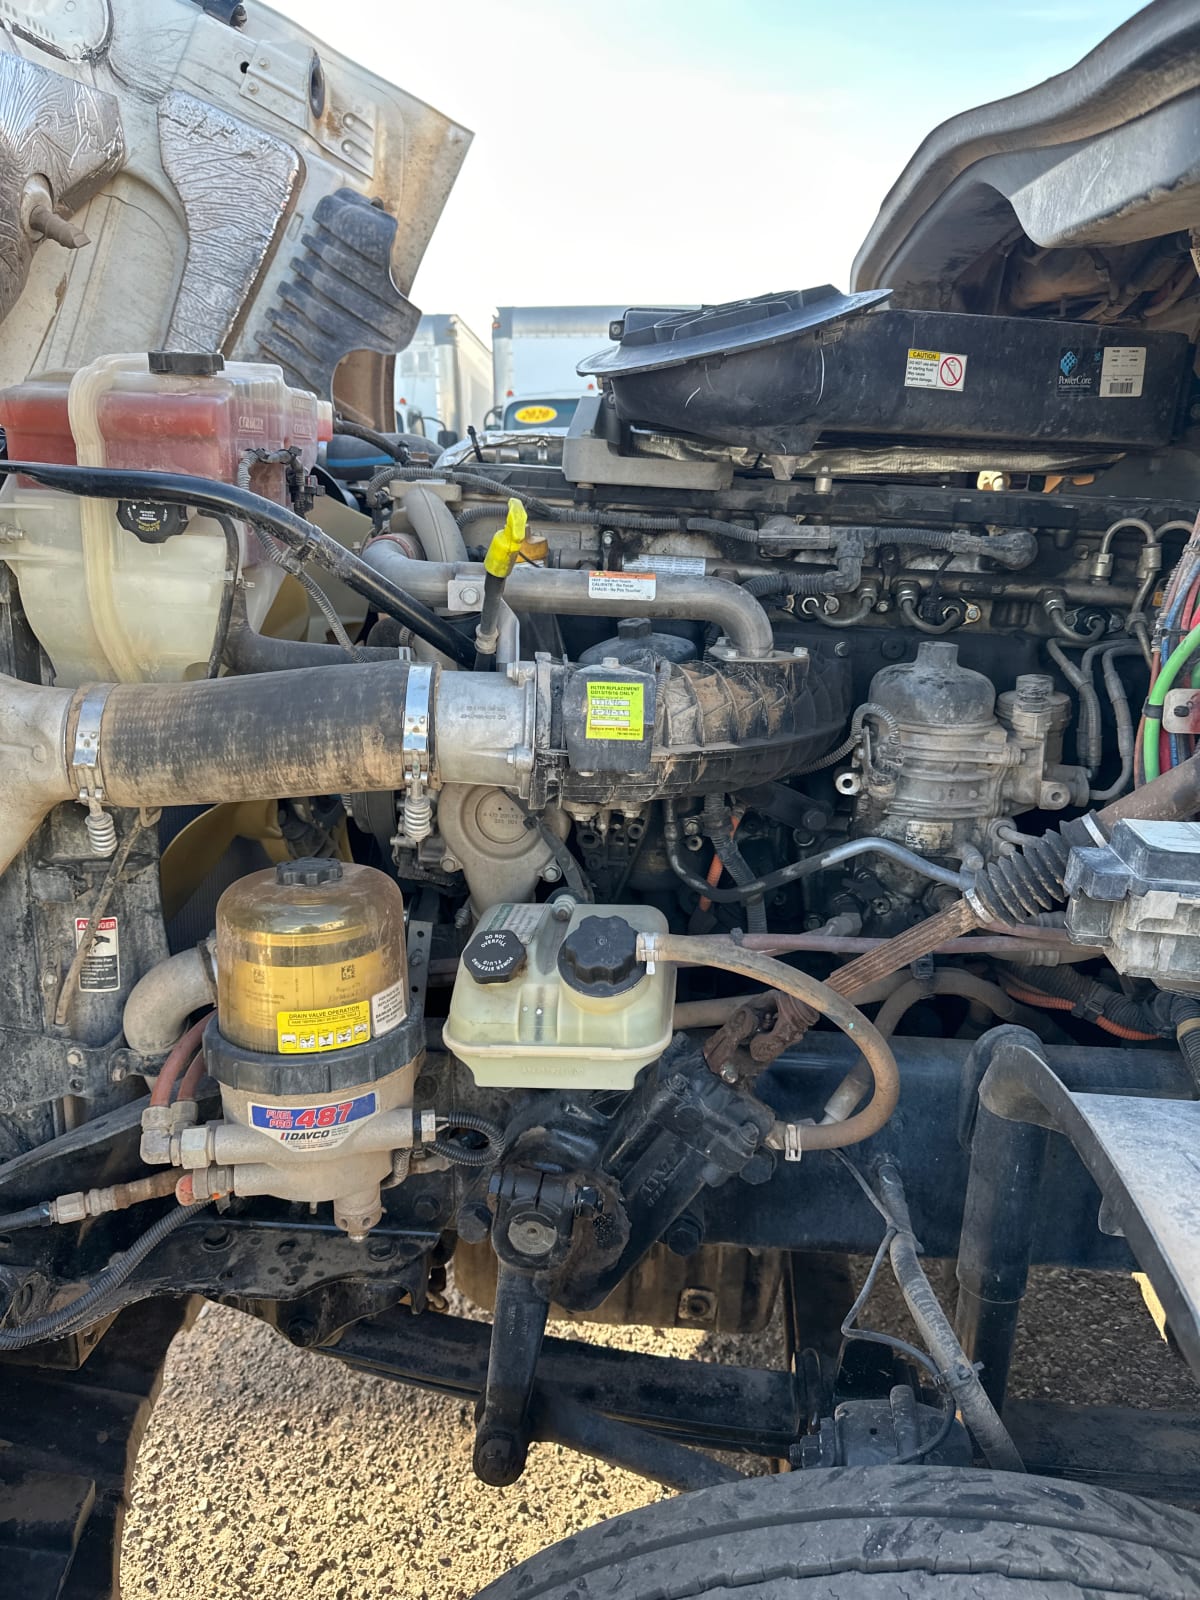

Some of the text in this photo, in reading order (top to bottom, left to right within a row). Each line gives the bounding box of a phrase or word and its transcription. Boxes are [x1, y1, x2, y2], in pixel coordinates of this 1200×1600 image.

[912, 351, 937, 360] CAUTION
[1058, 376, 1092, 385] PowerCore
[481, 938, 507, 948] OVERFILL
[471, 956, 514, 972] POWER STEERING
[308, 1010, 327, 1018] VALVE
[327, 1005, 360, 1016] OPERATION
[266, 1109, 293, 1120] FUEL
[294, 1101, 354, 1129] 487
[269, 1119, 292, 1129] PRO
[290, 1130, 330, 1140] DAVCO
